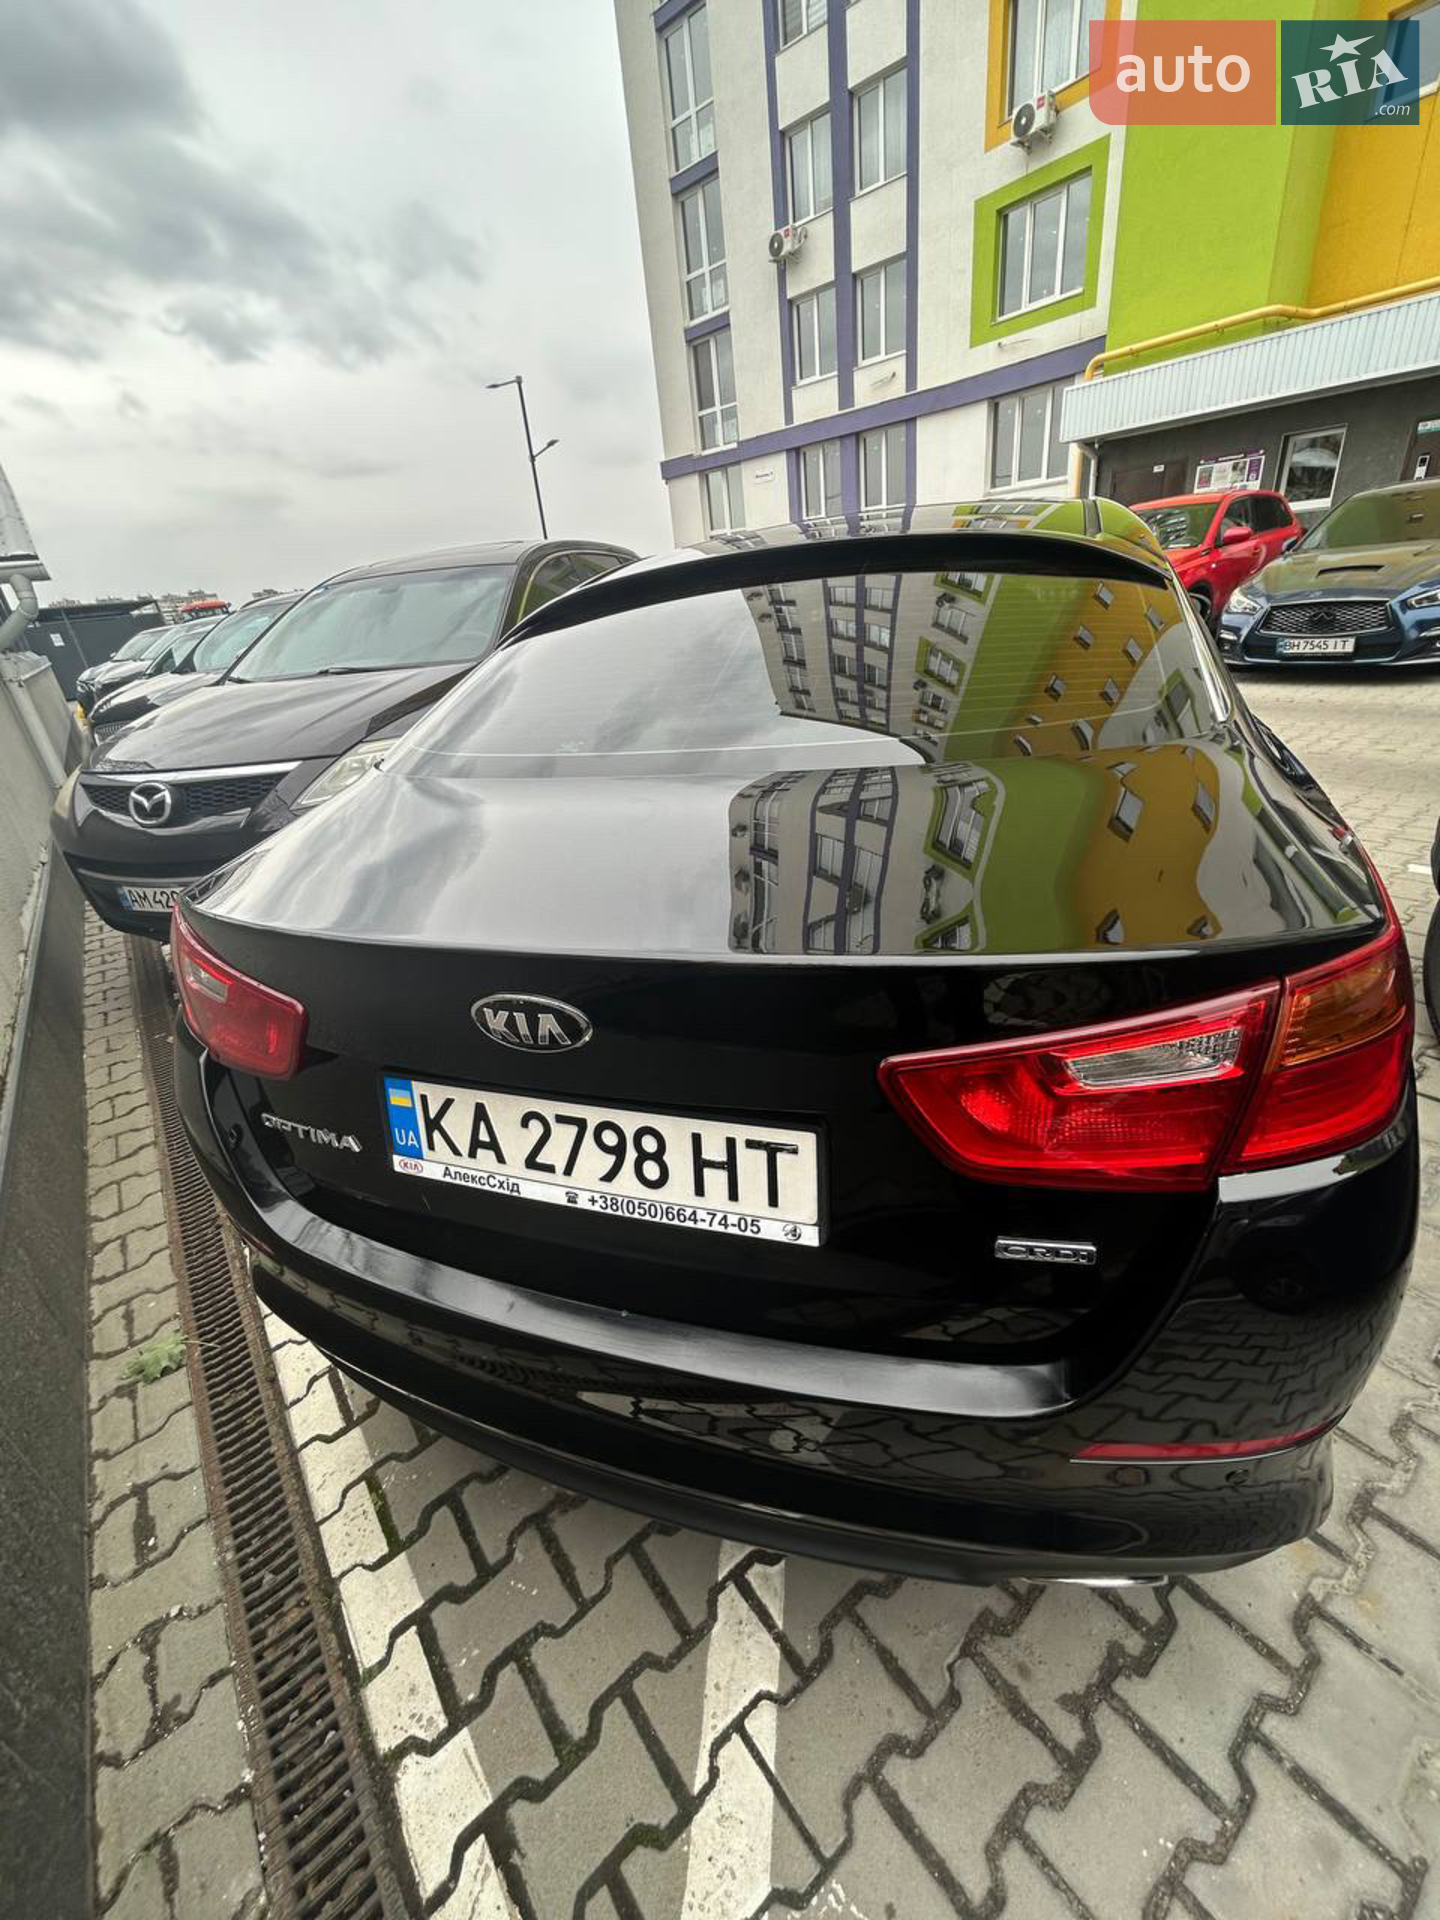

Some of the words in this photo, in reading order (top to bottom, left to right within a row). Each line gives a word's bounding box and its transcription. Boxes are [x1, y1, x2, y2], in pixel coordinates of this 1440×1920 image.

[128, 889, 153, 908] AM
[483, 1007, 572, 1045] KIA
[394, 1128, 419, 1149] UA
[420, 1093, 507, 1165] KA
[520, 1110, 670, 1190] 2798
[691, 1132, 799, 1209] HT
[402, 1161, 420, 1171] KIA
[442, 1166, 521, 1195] АлексСхід
[587, 1194, 762, 1235] +38(050)664-74-05
